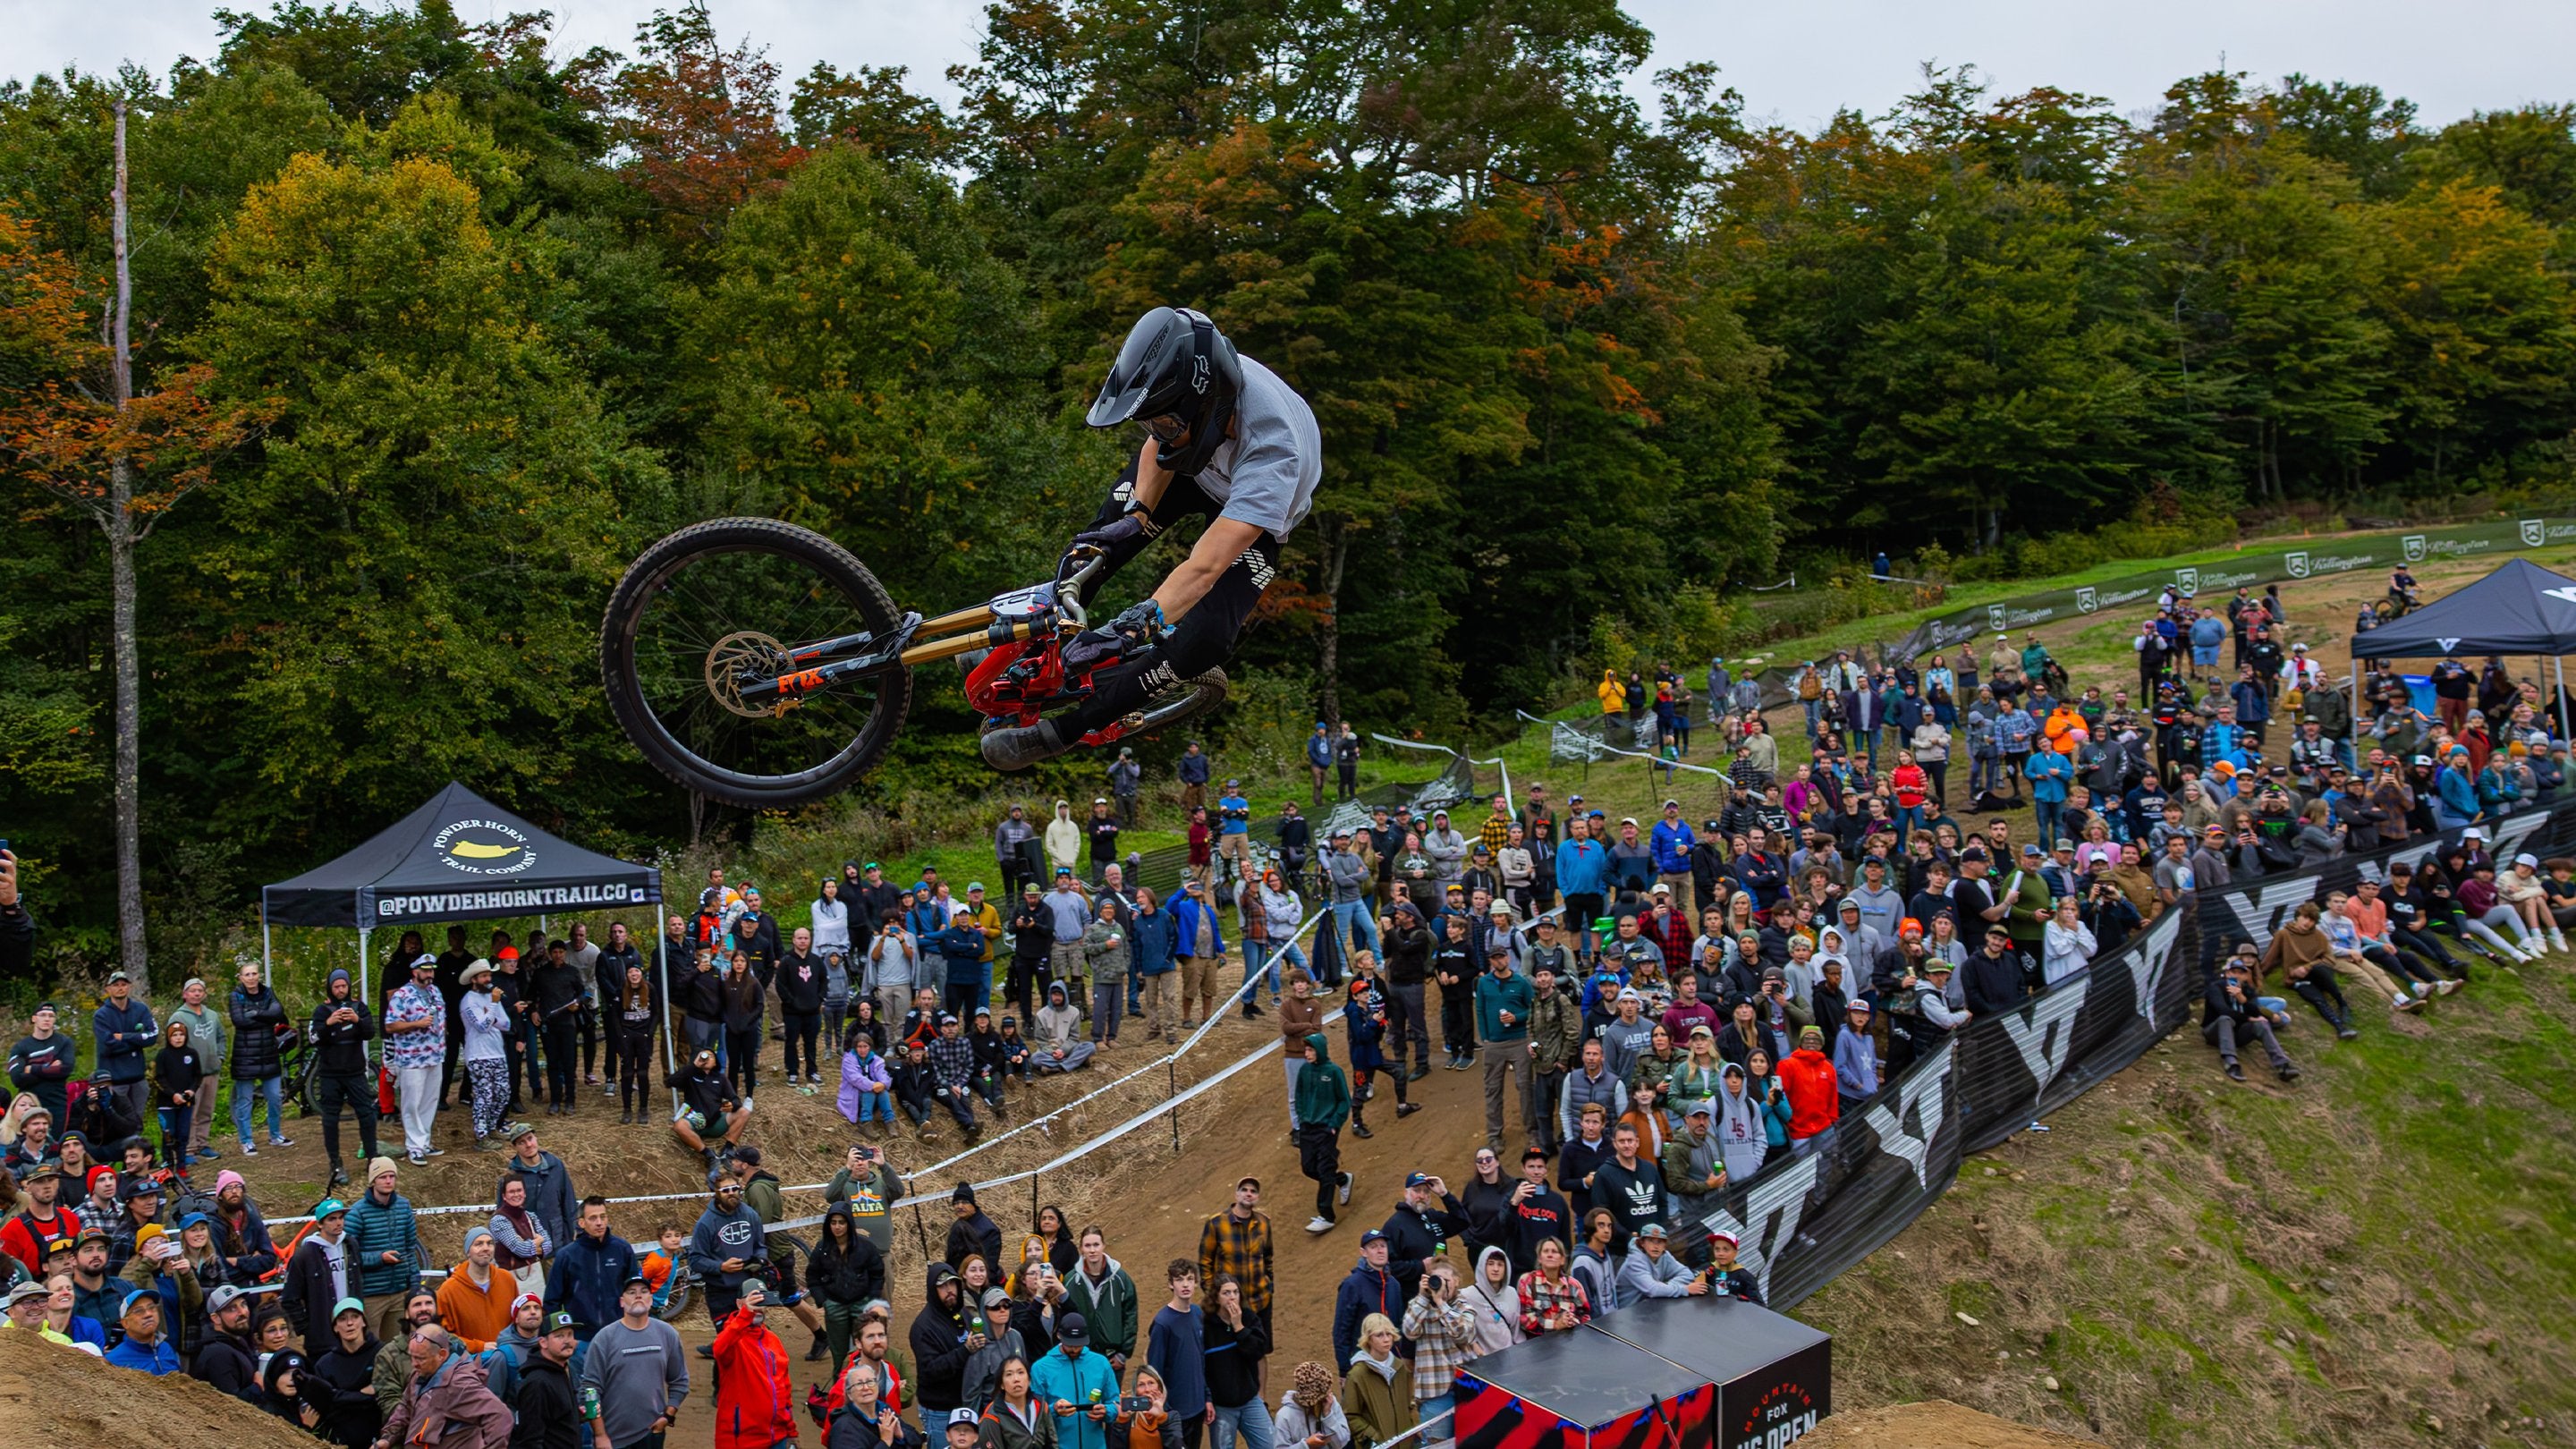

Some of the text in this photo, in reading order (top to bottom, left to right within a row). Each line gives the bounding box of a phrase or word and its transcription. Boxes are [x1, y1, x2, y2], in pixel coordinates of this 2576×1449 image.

[777, 666, 825, 693] FOX
[433, 819, 528, 849] POWDER HORN
[442, 851, 537, 875] TRAIL COMPANY
[378, 884, 628, 916] @POWDERHORNTRAILCO
[852, 1201, 885, 1213] ALTA
[1630, 1205, 1658, 1216] adidas
[1767, 1402, 1788, 1422] FOX
[1767, 1410, 1817, 1449] OPEN
